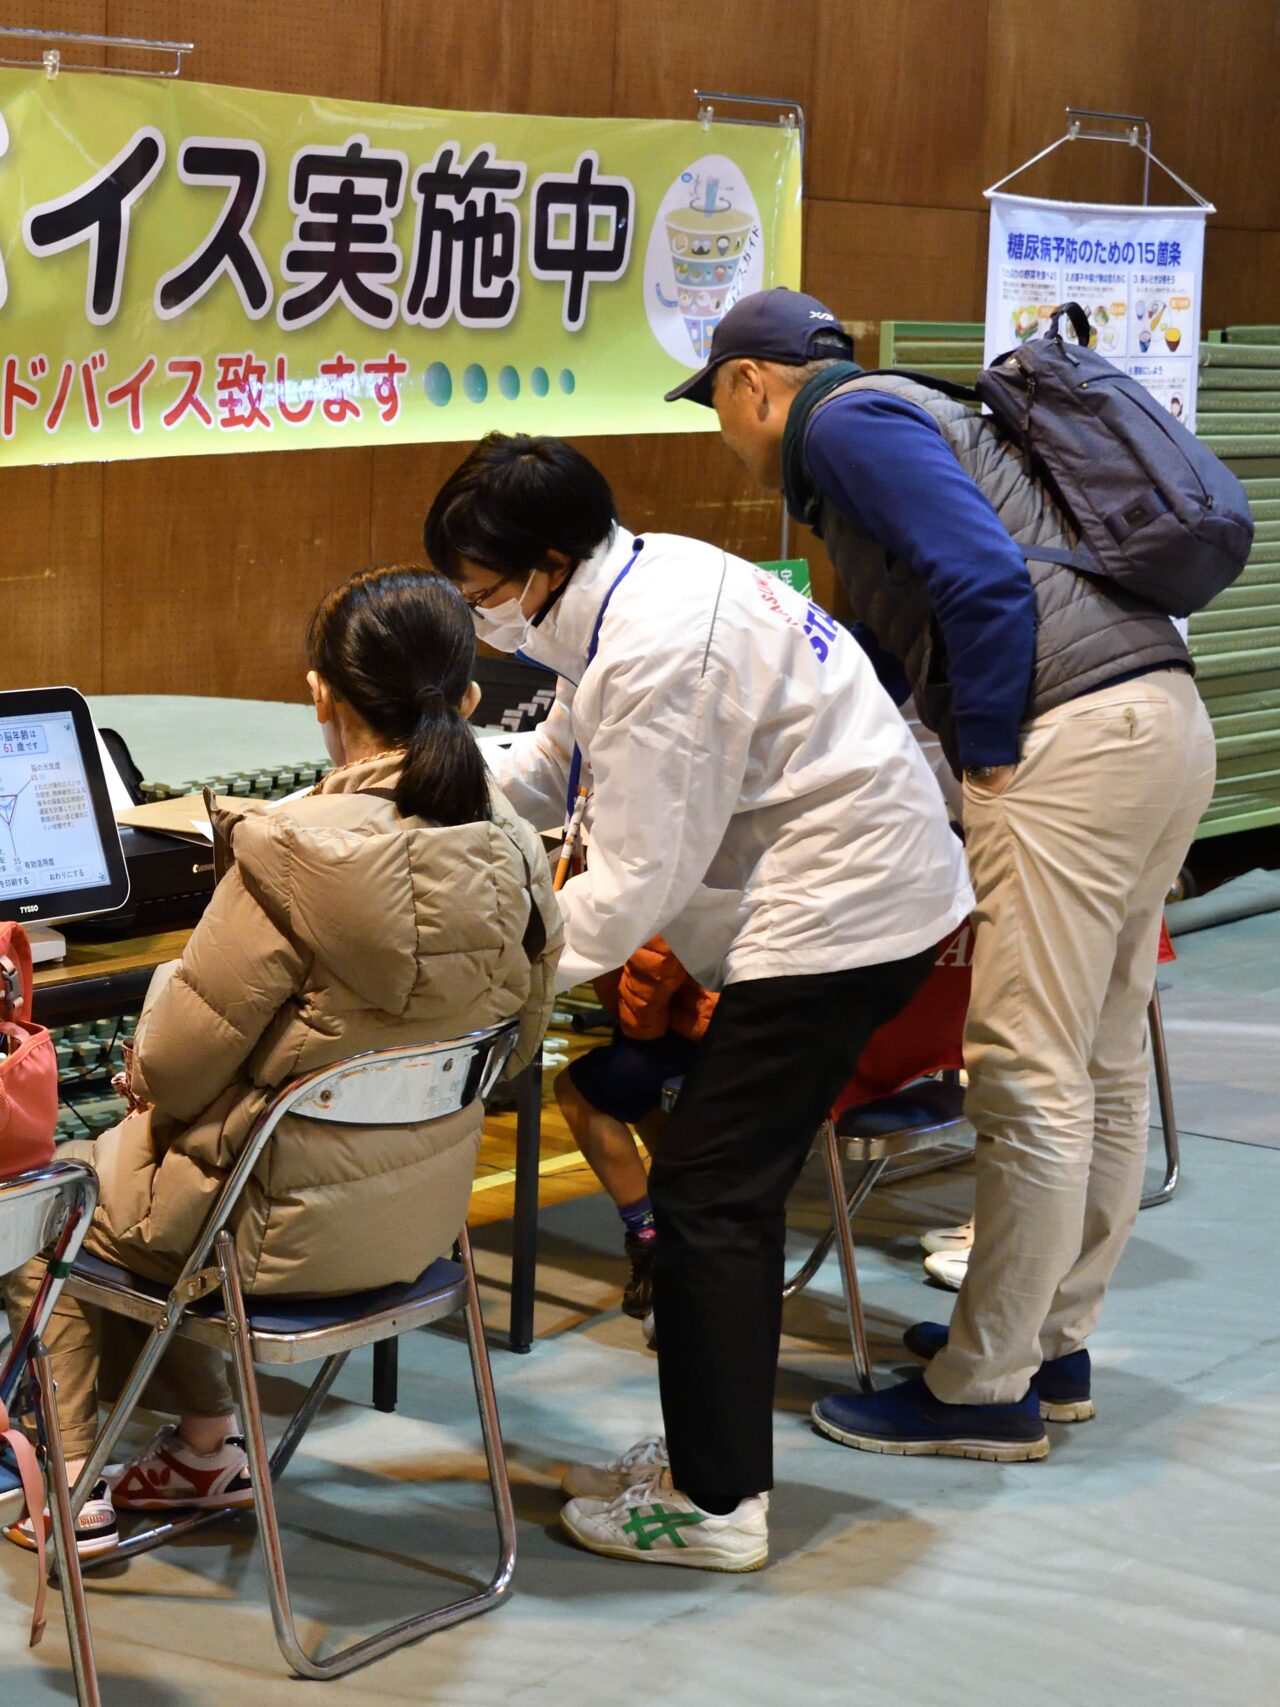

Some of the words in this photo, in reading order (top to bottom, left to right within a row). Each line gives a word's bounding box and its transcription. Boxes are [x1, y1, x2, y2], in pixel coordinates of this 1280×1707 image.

[1007, 232, 1182, 267] 糖尿病予防のための15箇条
[3, 744, 14, 752] 61
[48, 869, 85, 881] おわりにする
[19, 904, 39, 914] TYSSO
